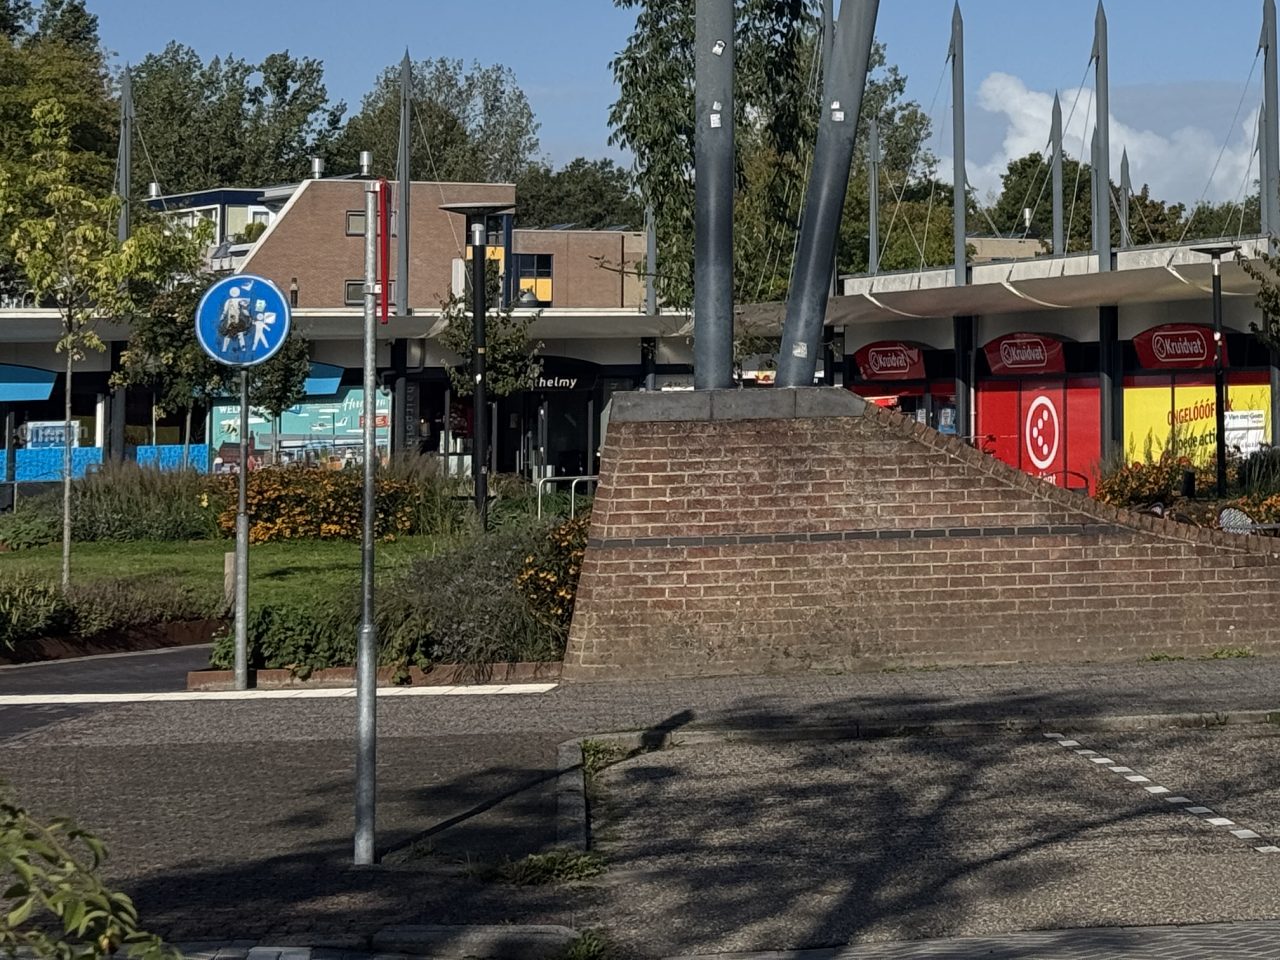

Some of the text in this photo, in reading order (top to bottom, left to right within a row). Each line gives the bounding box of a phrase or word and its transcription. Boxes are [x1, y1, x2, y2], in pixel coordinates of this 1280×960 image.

[1011, 343, 1044, 361] Kruidvat
[1165, 337, 1204, 355] Kruidvat
[878, 352, 907, 368] Kruidvat
